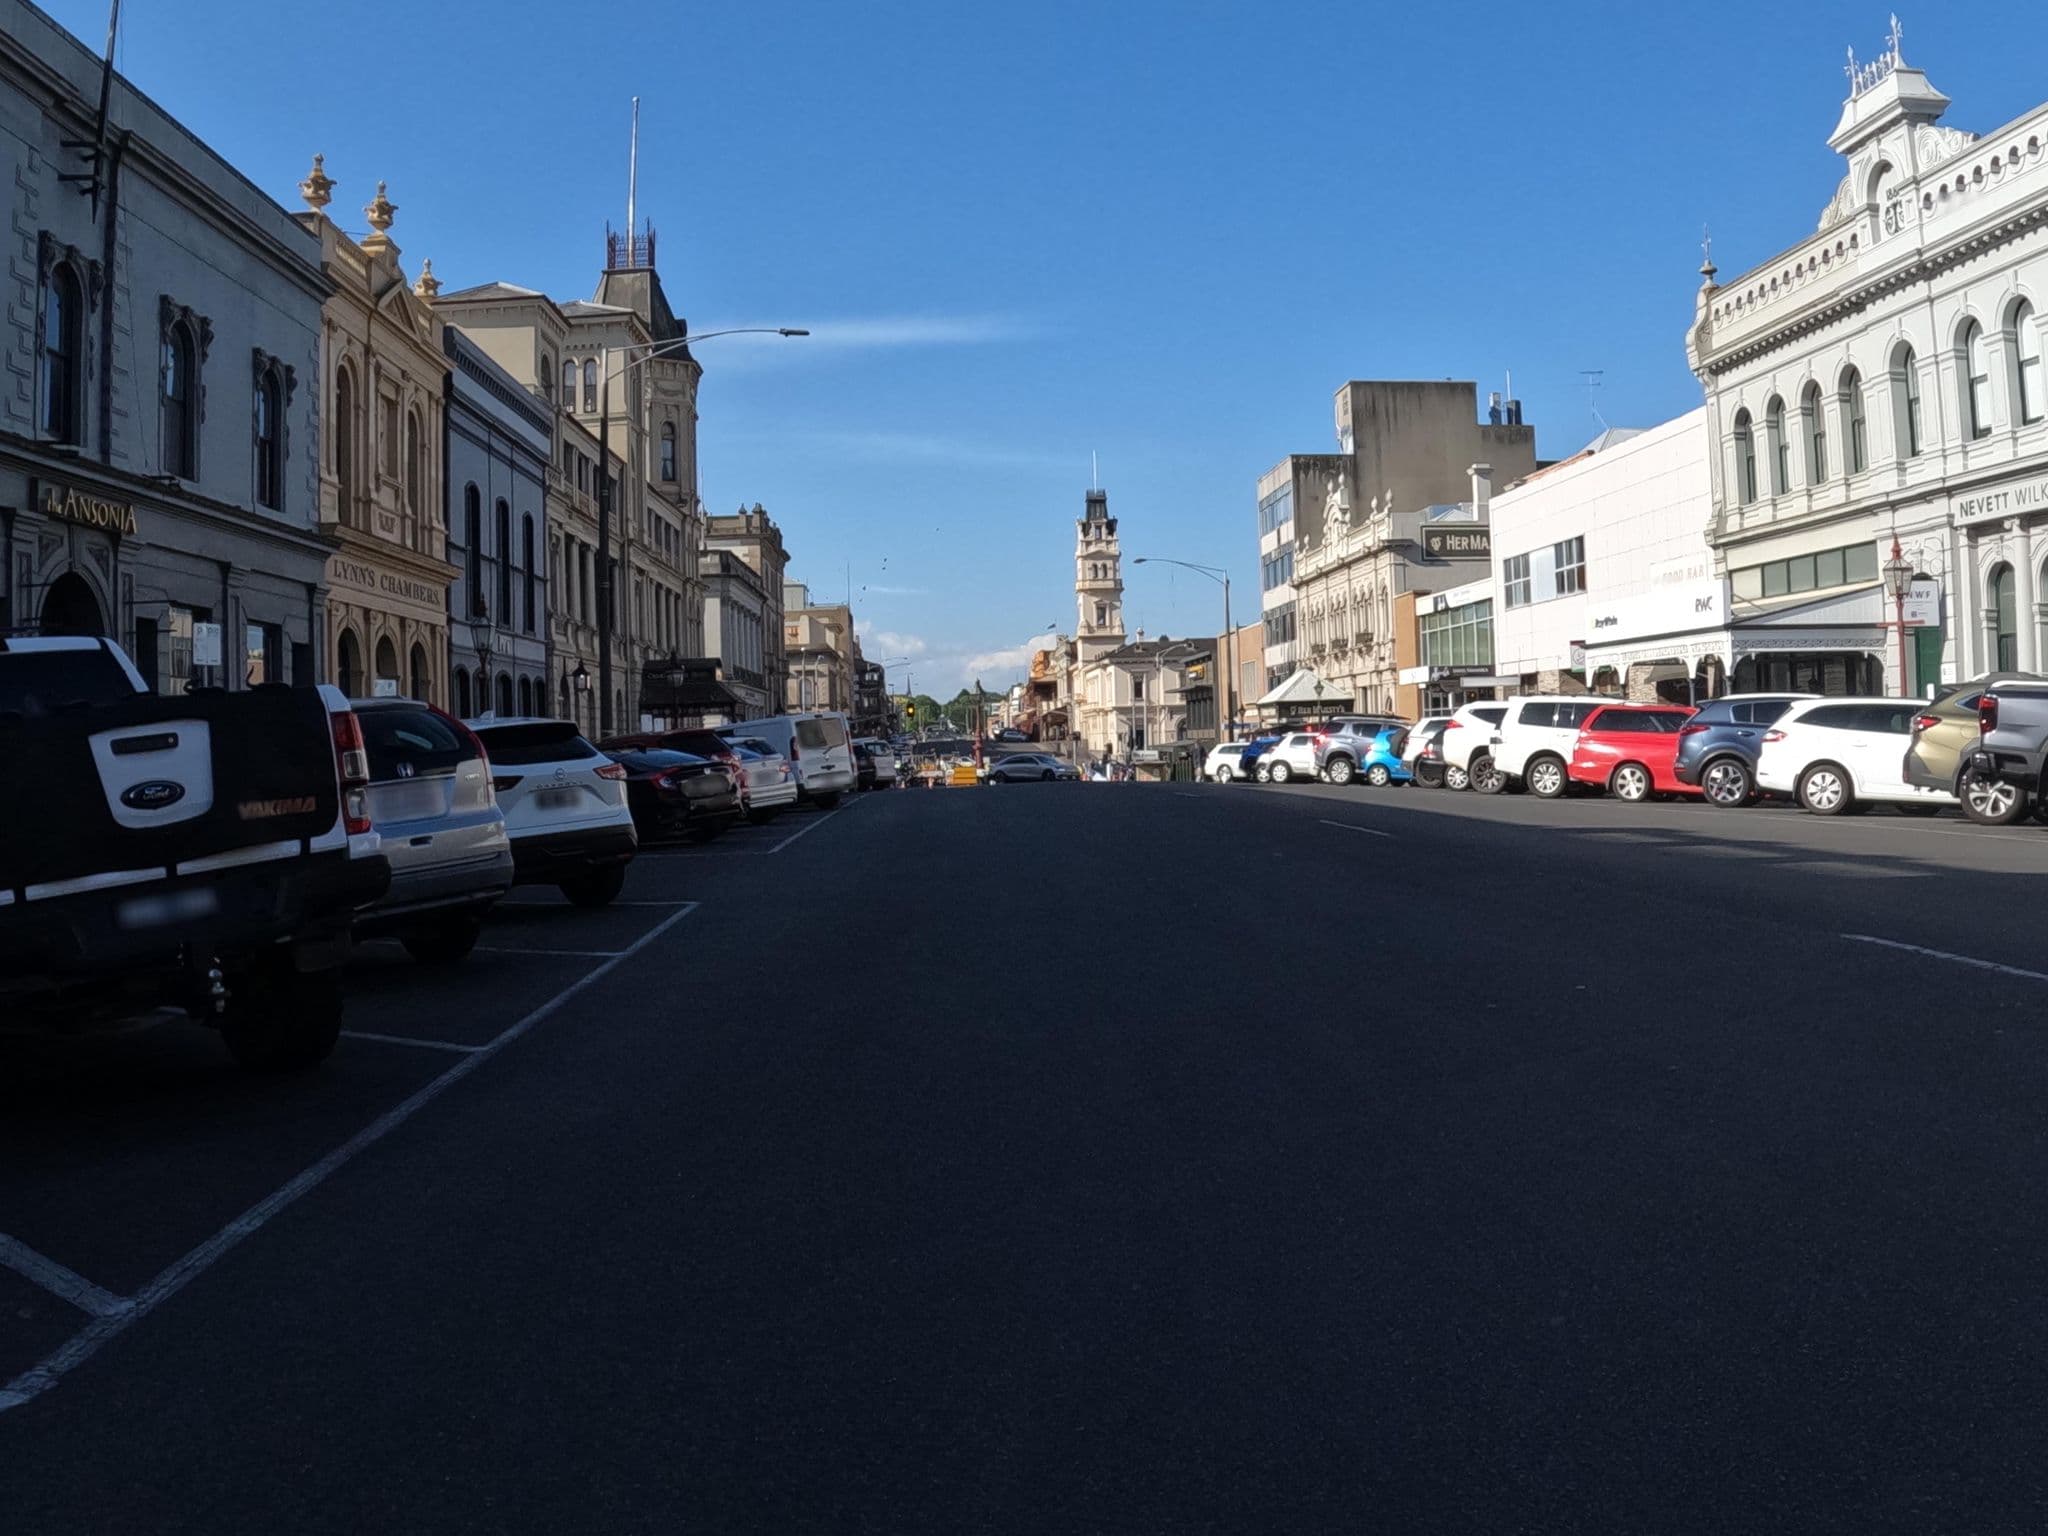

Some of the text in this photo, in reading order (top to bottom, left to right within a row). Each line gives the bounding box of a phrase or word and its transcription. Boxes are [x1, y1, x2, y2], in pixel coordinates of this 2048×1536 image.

[65, 487, 137, 534] ANSONIA
[1960, 491, 2009, 518] NEVETT
[334, 559, 376, 588] LYNN'S
